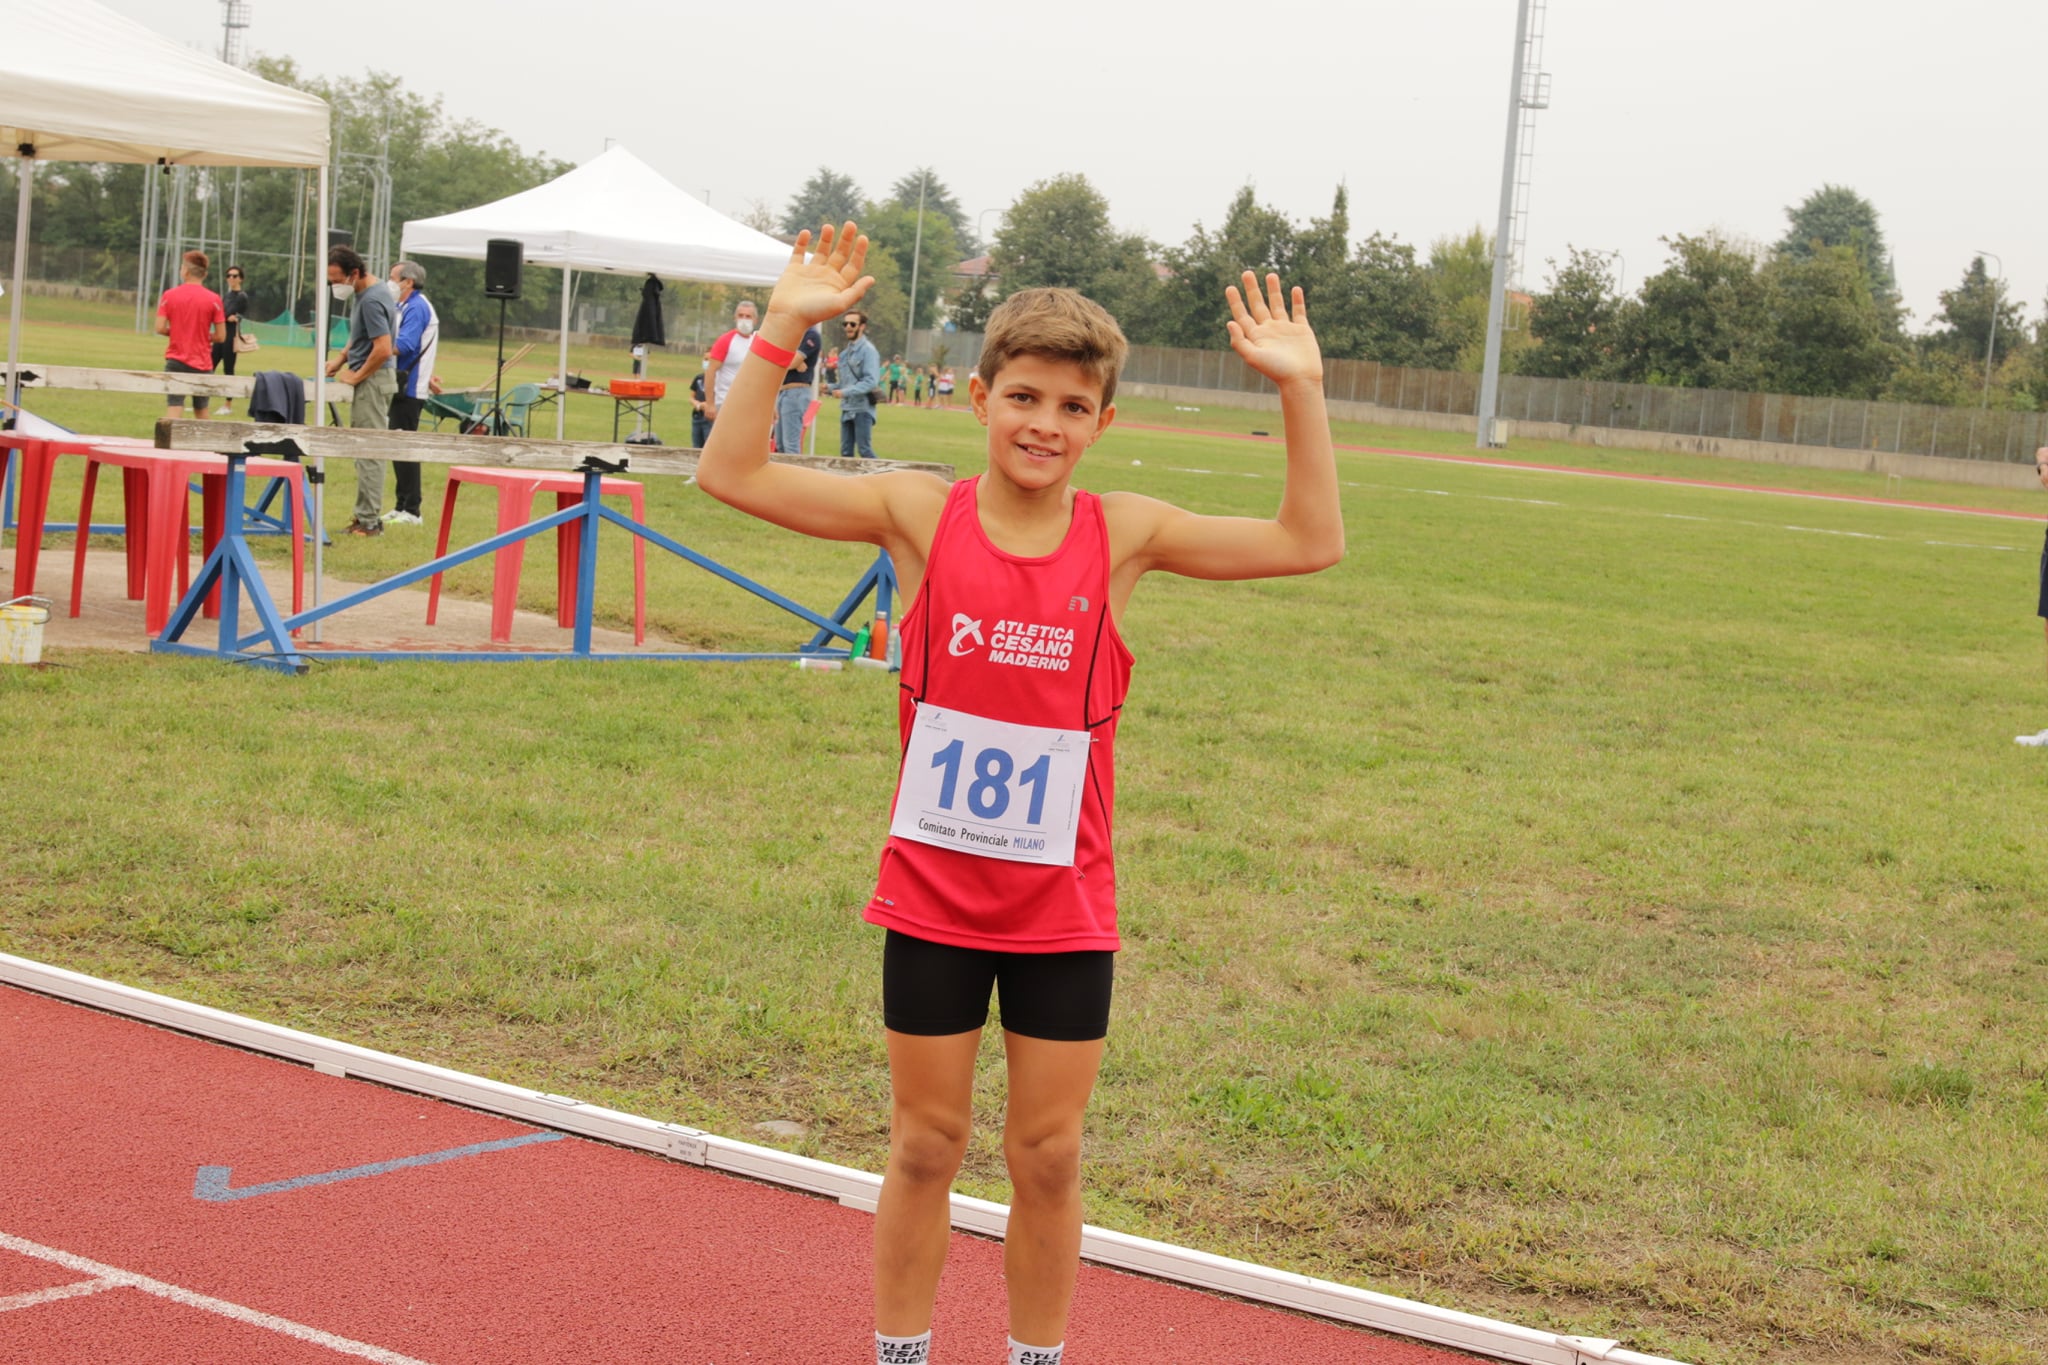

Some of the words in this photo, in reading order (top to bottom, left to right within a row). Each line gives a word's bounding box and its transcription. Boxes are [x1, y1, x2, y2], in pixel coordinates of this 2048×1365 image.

[992, 619, 1074, 642] ATLETICA
[990, 633, 1073, 657] CESANO
[988, 649, 1070, 672] MADERNO
[930, 738, 1051, 825] 181
[918, 818, 956, 837] Comitato
[960, 827, 1008, 848] Provinciale
[1013, 836, 1045, 851] MILANO
